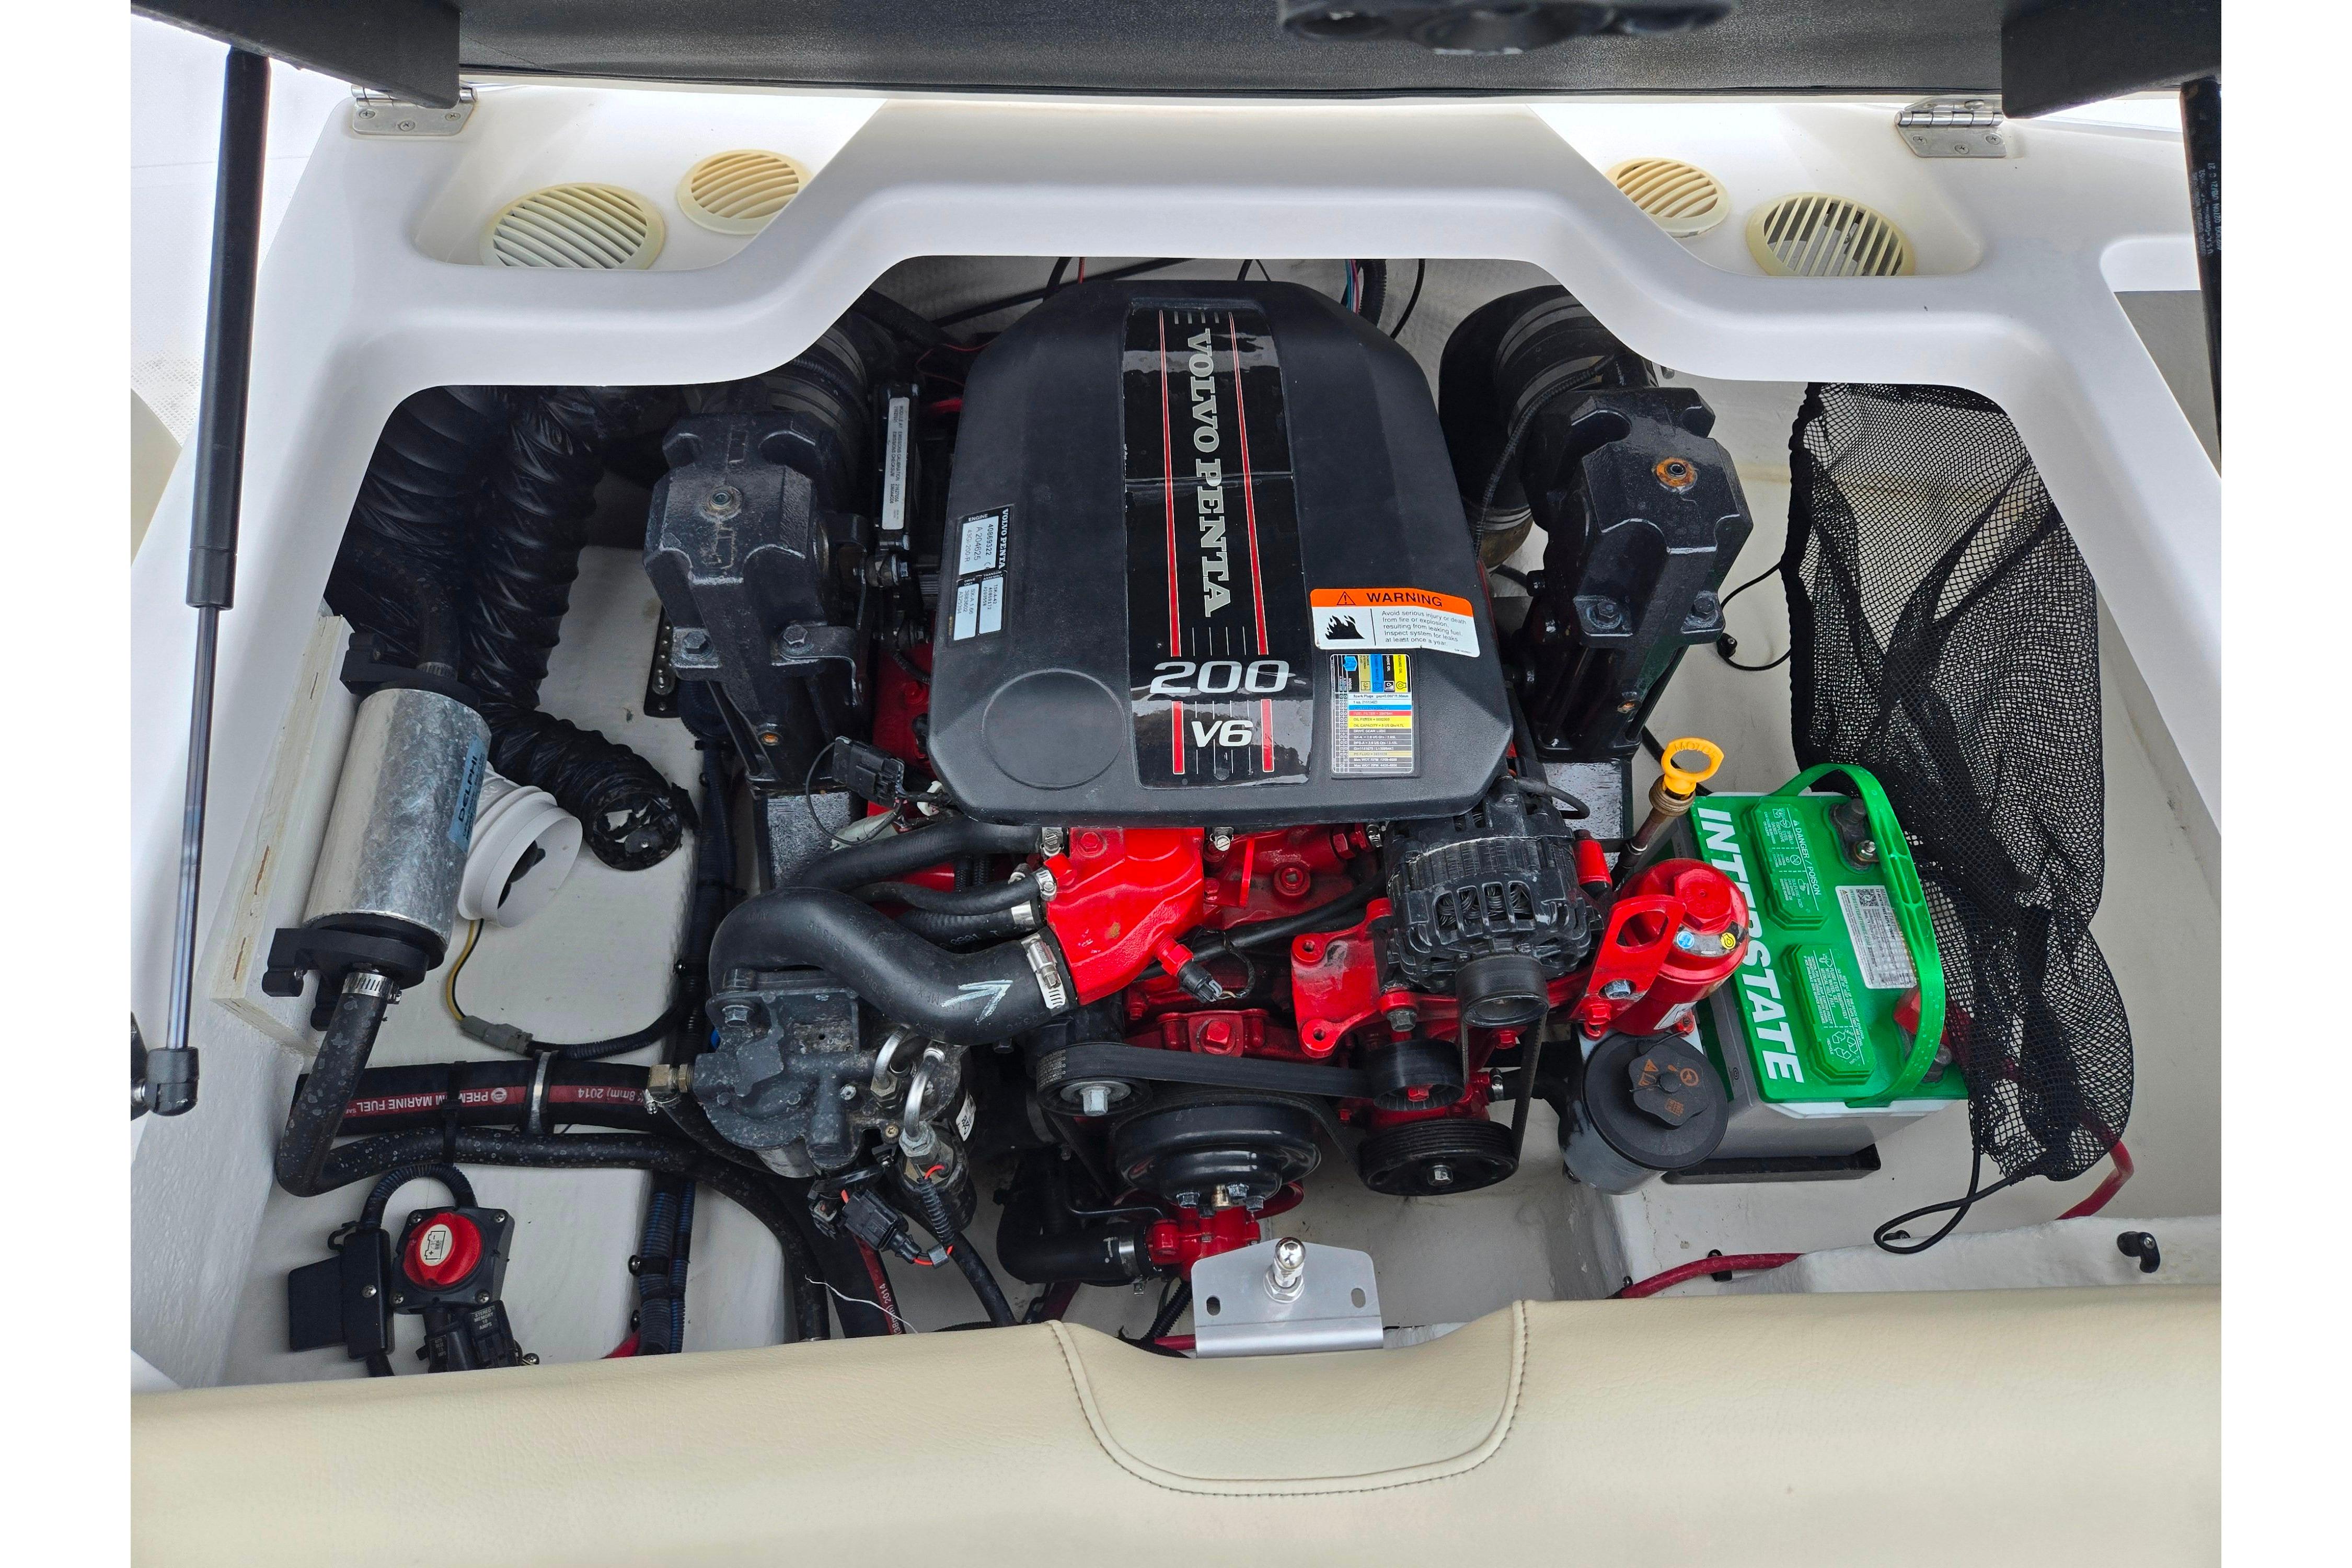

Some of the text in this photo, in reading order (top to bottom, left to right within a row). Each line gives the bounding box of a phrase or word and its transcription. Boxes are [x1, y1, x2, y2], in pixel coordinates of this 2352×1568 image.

[1187, 327, 1230, 618] VOLVO PENTA
[974, 533, 982, 560] 204625
[999, 537, 1007, 569] PENTA
[1366, 593, 1442, 607] WARNING
[1428, 626, 1449, 635] leaking
[1150, 660, 1290, 694] 200
[1191, 720, 1253, 747] V6
[457, 755, 478, 822] DELPHI
[1775, 822, 1785, 843] EXPLOSIVE
[1795, 828, 1809, 858] DANGER
[1807, 867, 1821, 895] POISON
[1880, 889, 1889, 906] MARINE
[1837, 993, 1848, 1019] IMMEDIATELY
[388, 1096, 432, 1109] MARINE
[436, 1091, 489, 1104] PREMM
[578, 1088, 604, 1098] 2014
[356, 1101, 385, 1112] FUEL
[879, 1283, 891, 1304] 2014
[474, 1312, 493, 1322] MEMORY
[475, 1309, 491, 1317] STEREO
